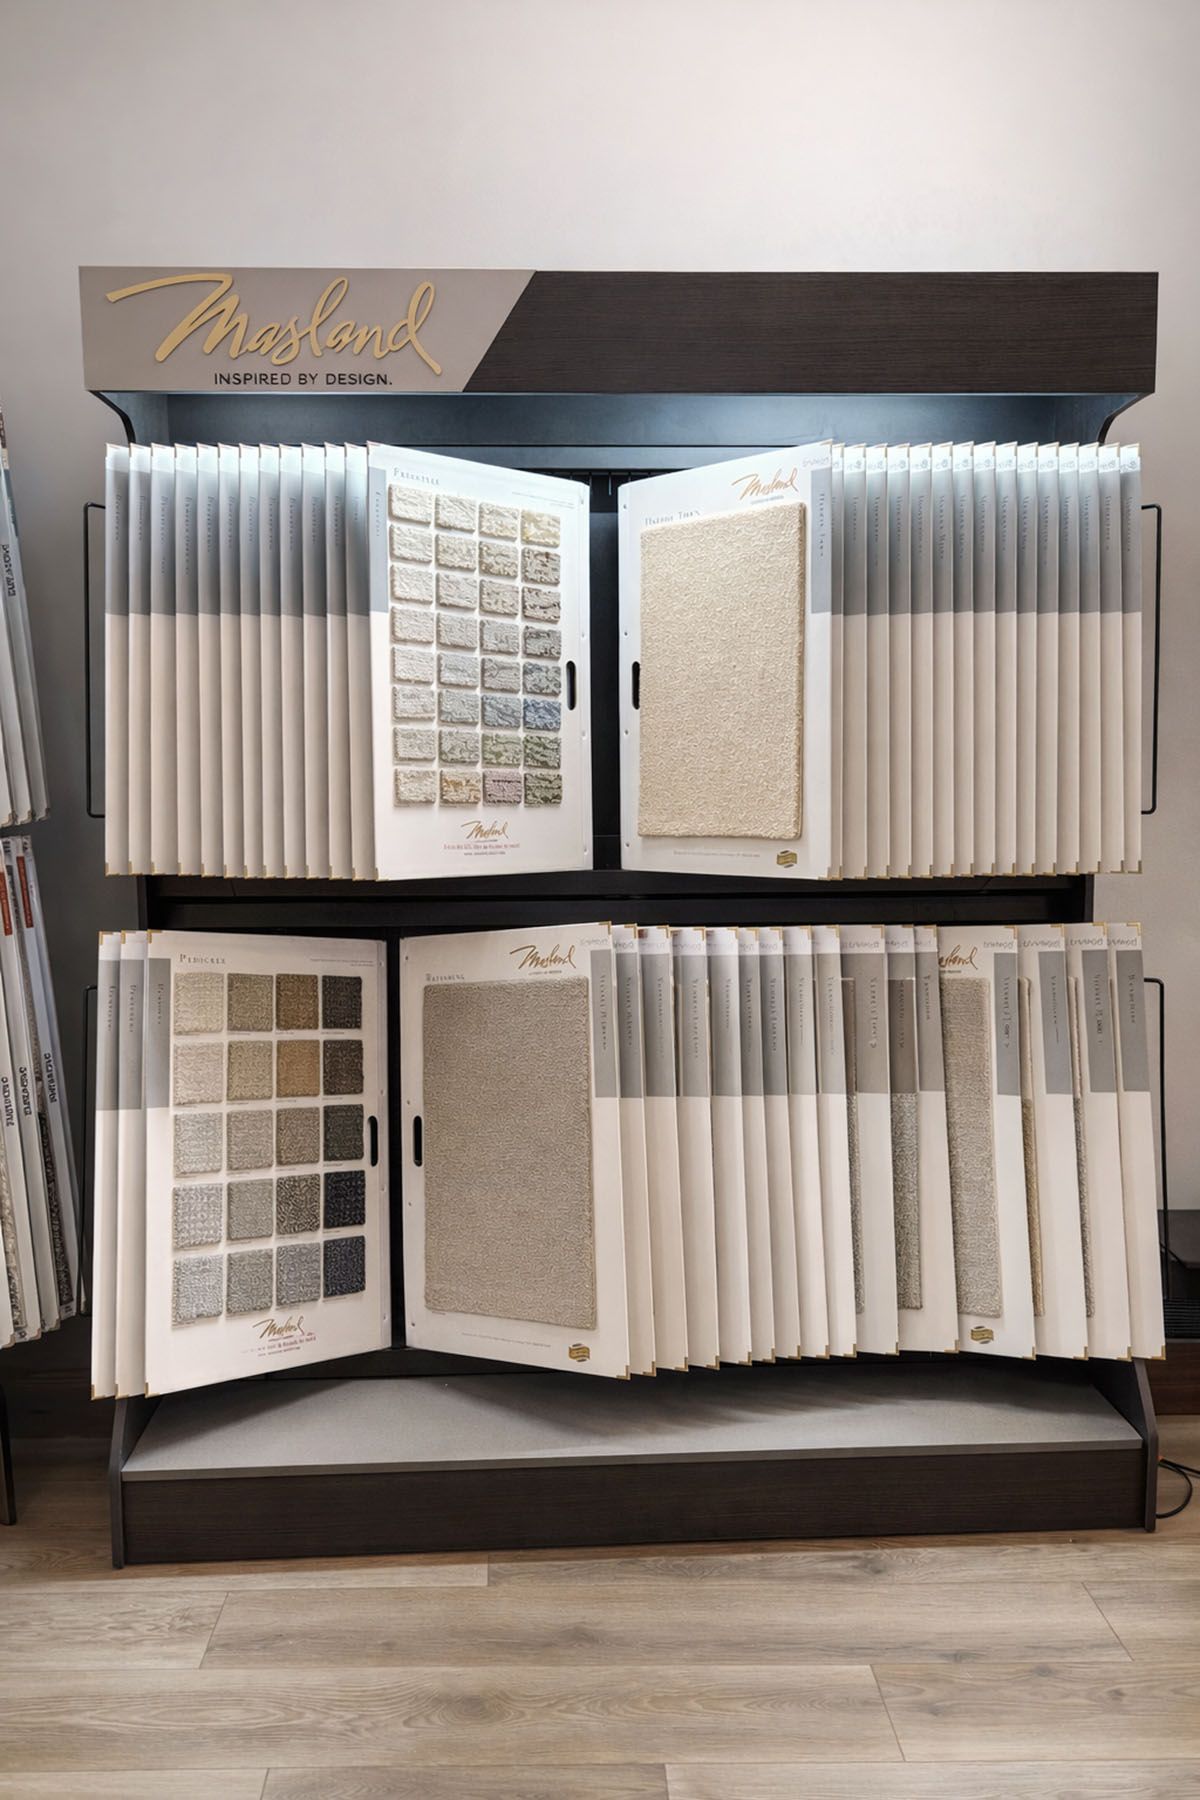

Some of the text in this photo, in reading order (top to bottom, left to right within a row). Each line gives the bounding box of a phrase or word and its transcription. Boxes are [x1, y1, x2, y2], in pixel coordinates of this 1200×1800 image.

[105, 273, 442, 376] Masland
[214, 373, 393, 386] INSPIRED BY DESIGN.
[509, 943, 577, 970] Masland
